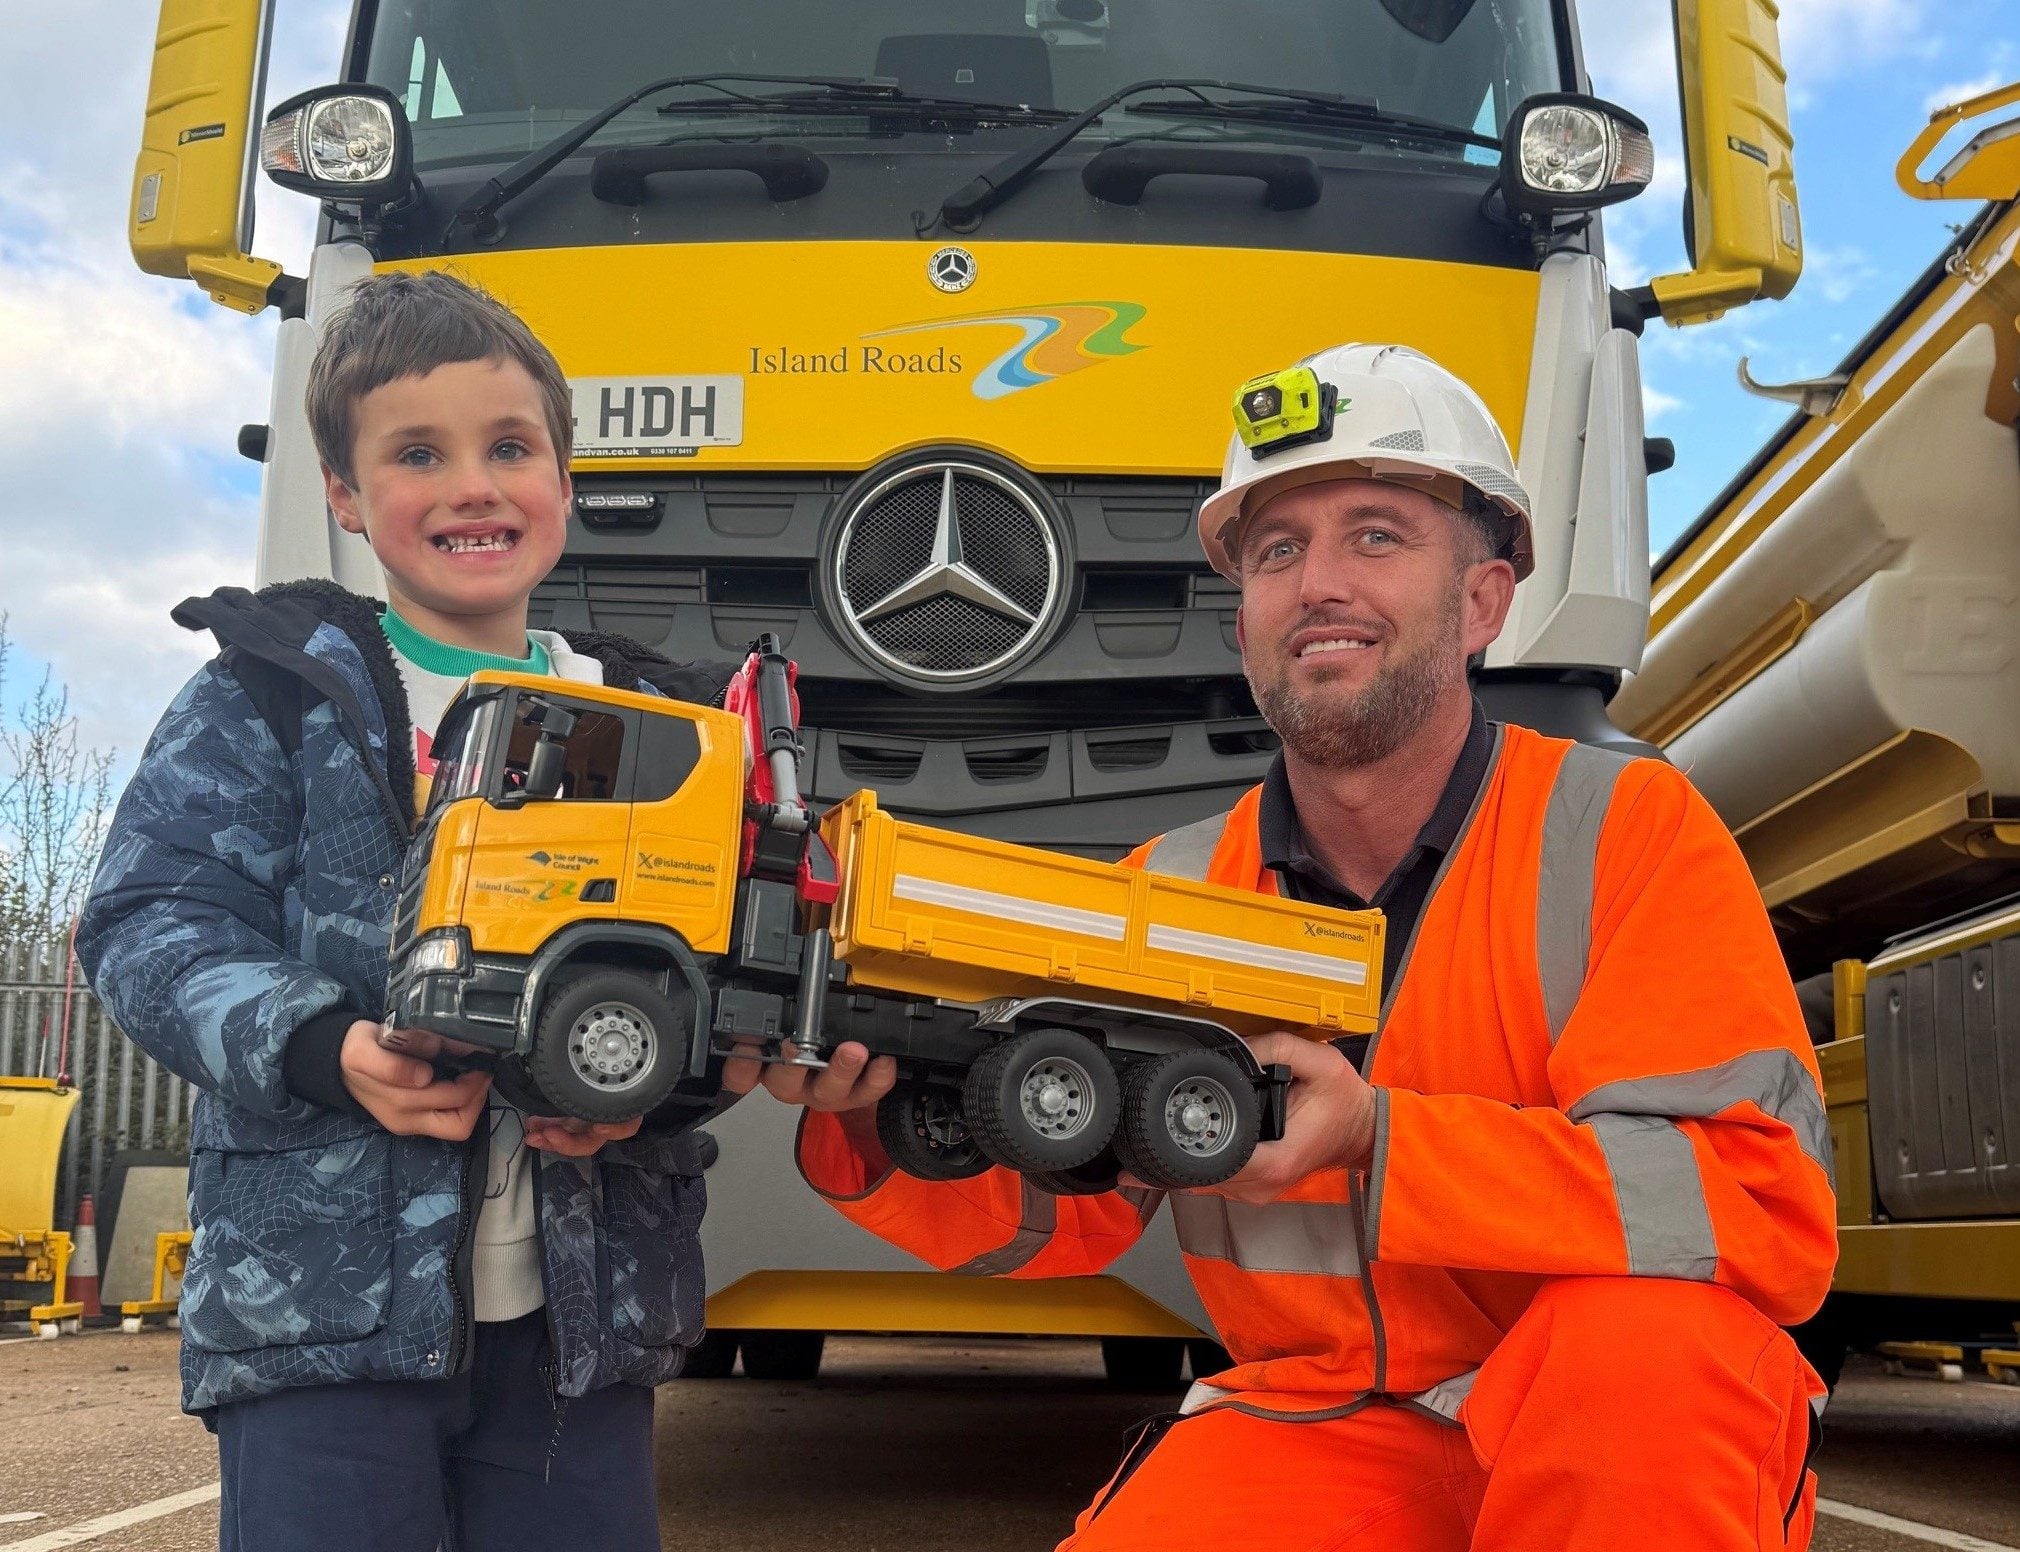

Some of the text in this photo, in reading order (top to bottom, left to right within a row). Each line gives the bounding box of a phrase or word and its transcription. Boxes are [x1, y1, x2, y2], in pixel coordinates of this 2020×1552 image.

[750, 346, 962, 374] Island Roads
[599, 386, 716, 437] HDH
[572, 448, 639, 457] andvan.co.uk
[553, 861, 580, 871] Council
[567, 854, 576, 863] of
[654, 857, 716, 873] @islandroads
[637, 872, 716, 887] www.islandroads.com
[476, 880, 531, 895] Island Roads
[1316, 926, 1365, 942] @islandroads
